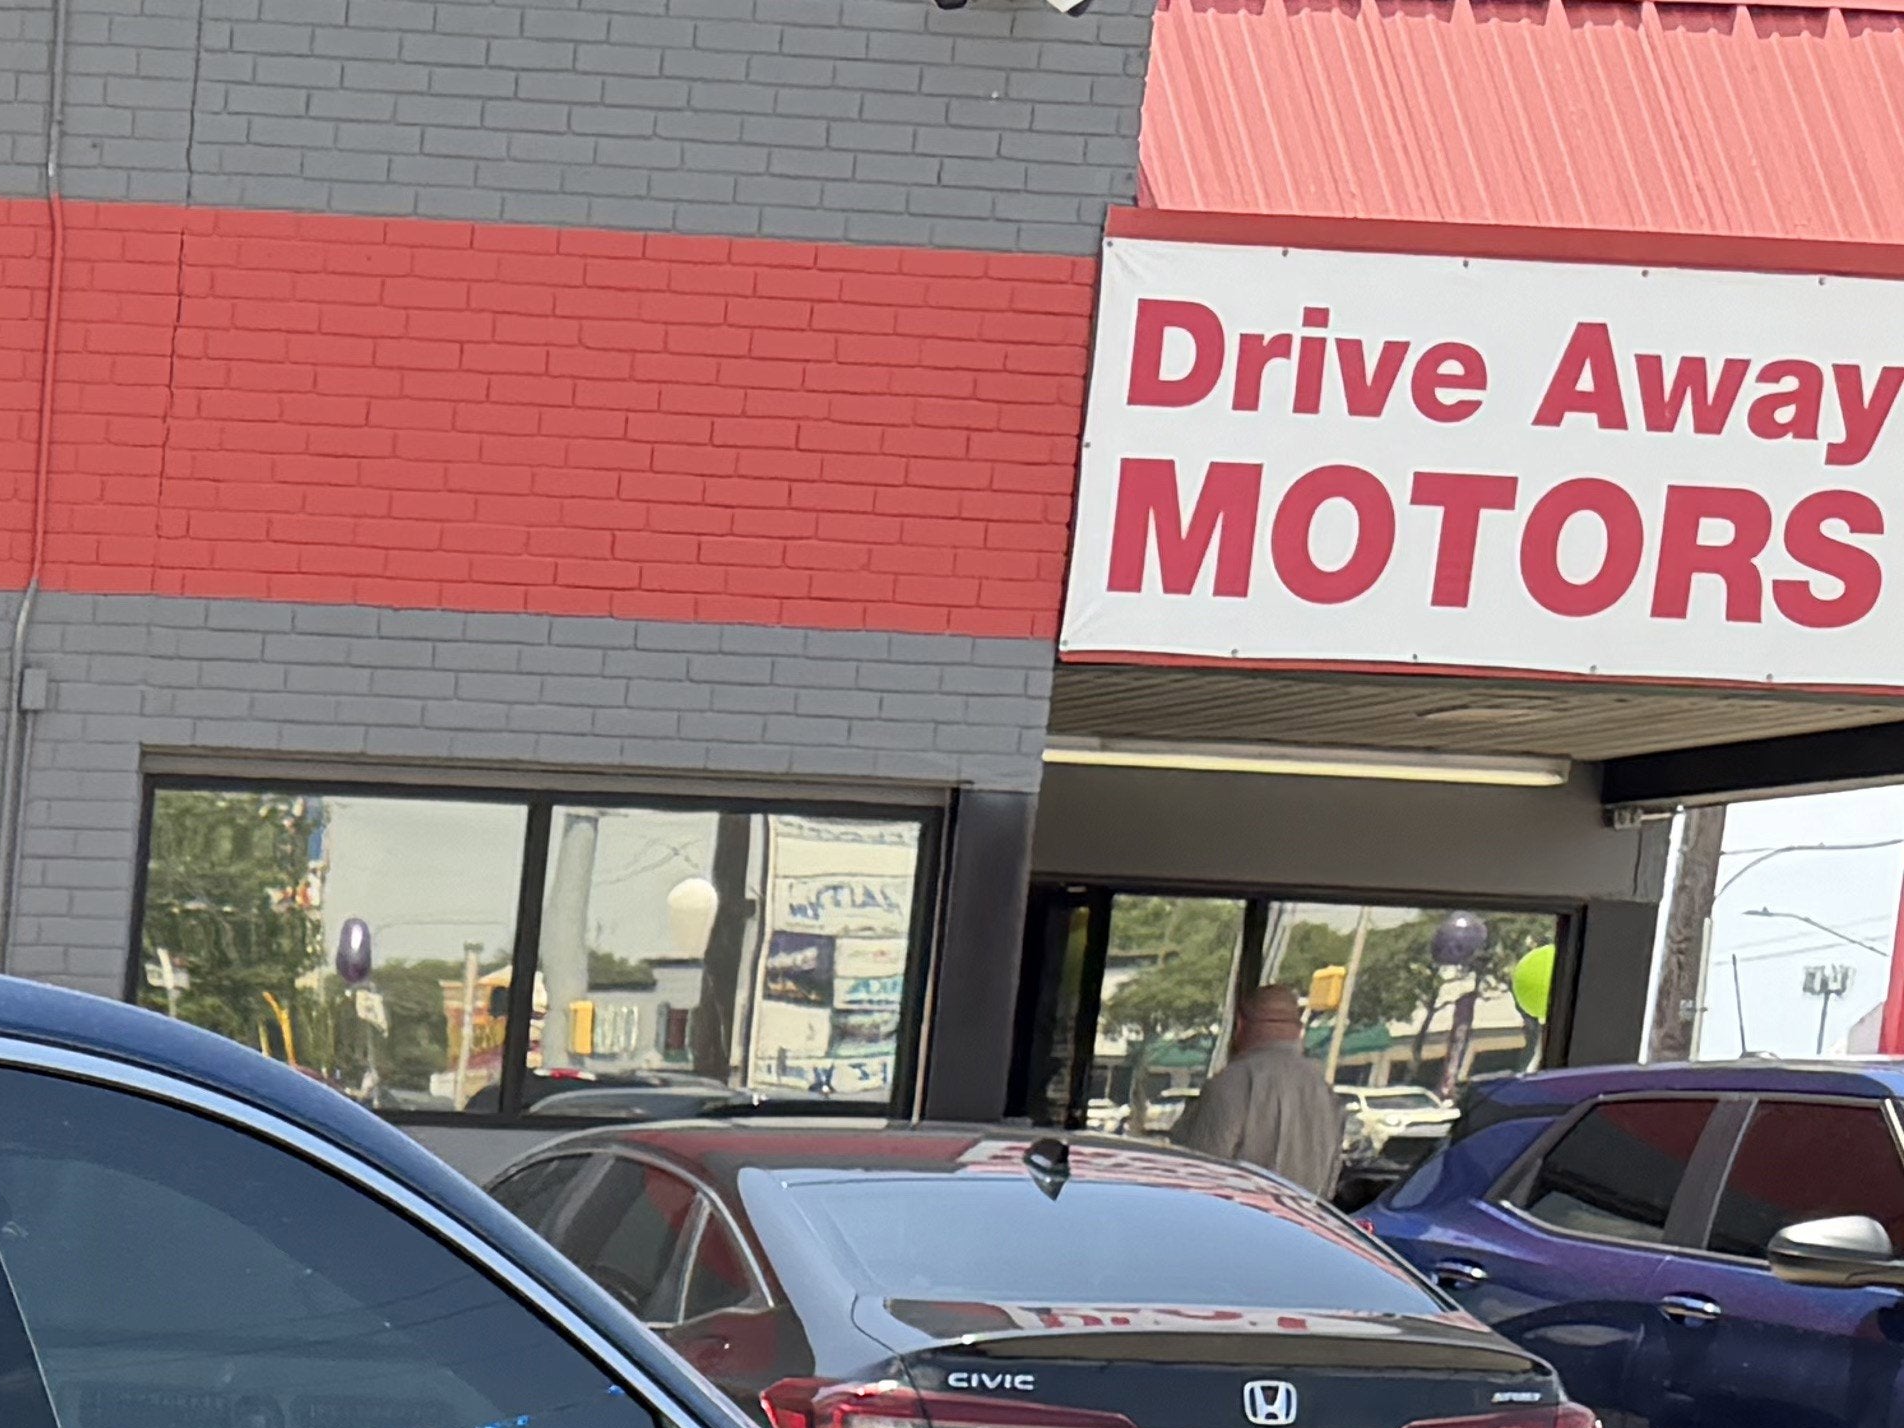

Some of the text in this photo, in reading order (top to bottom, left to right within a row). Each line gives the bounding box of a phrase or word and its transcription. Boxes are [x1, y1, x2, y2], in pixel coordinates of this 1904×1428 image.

[1126, 297, 1904, 465] Drive Away
[1106, 457, 1885, 628] MOTORS
[947, 1371, 1035, 1391] CIVIC
